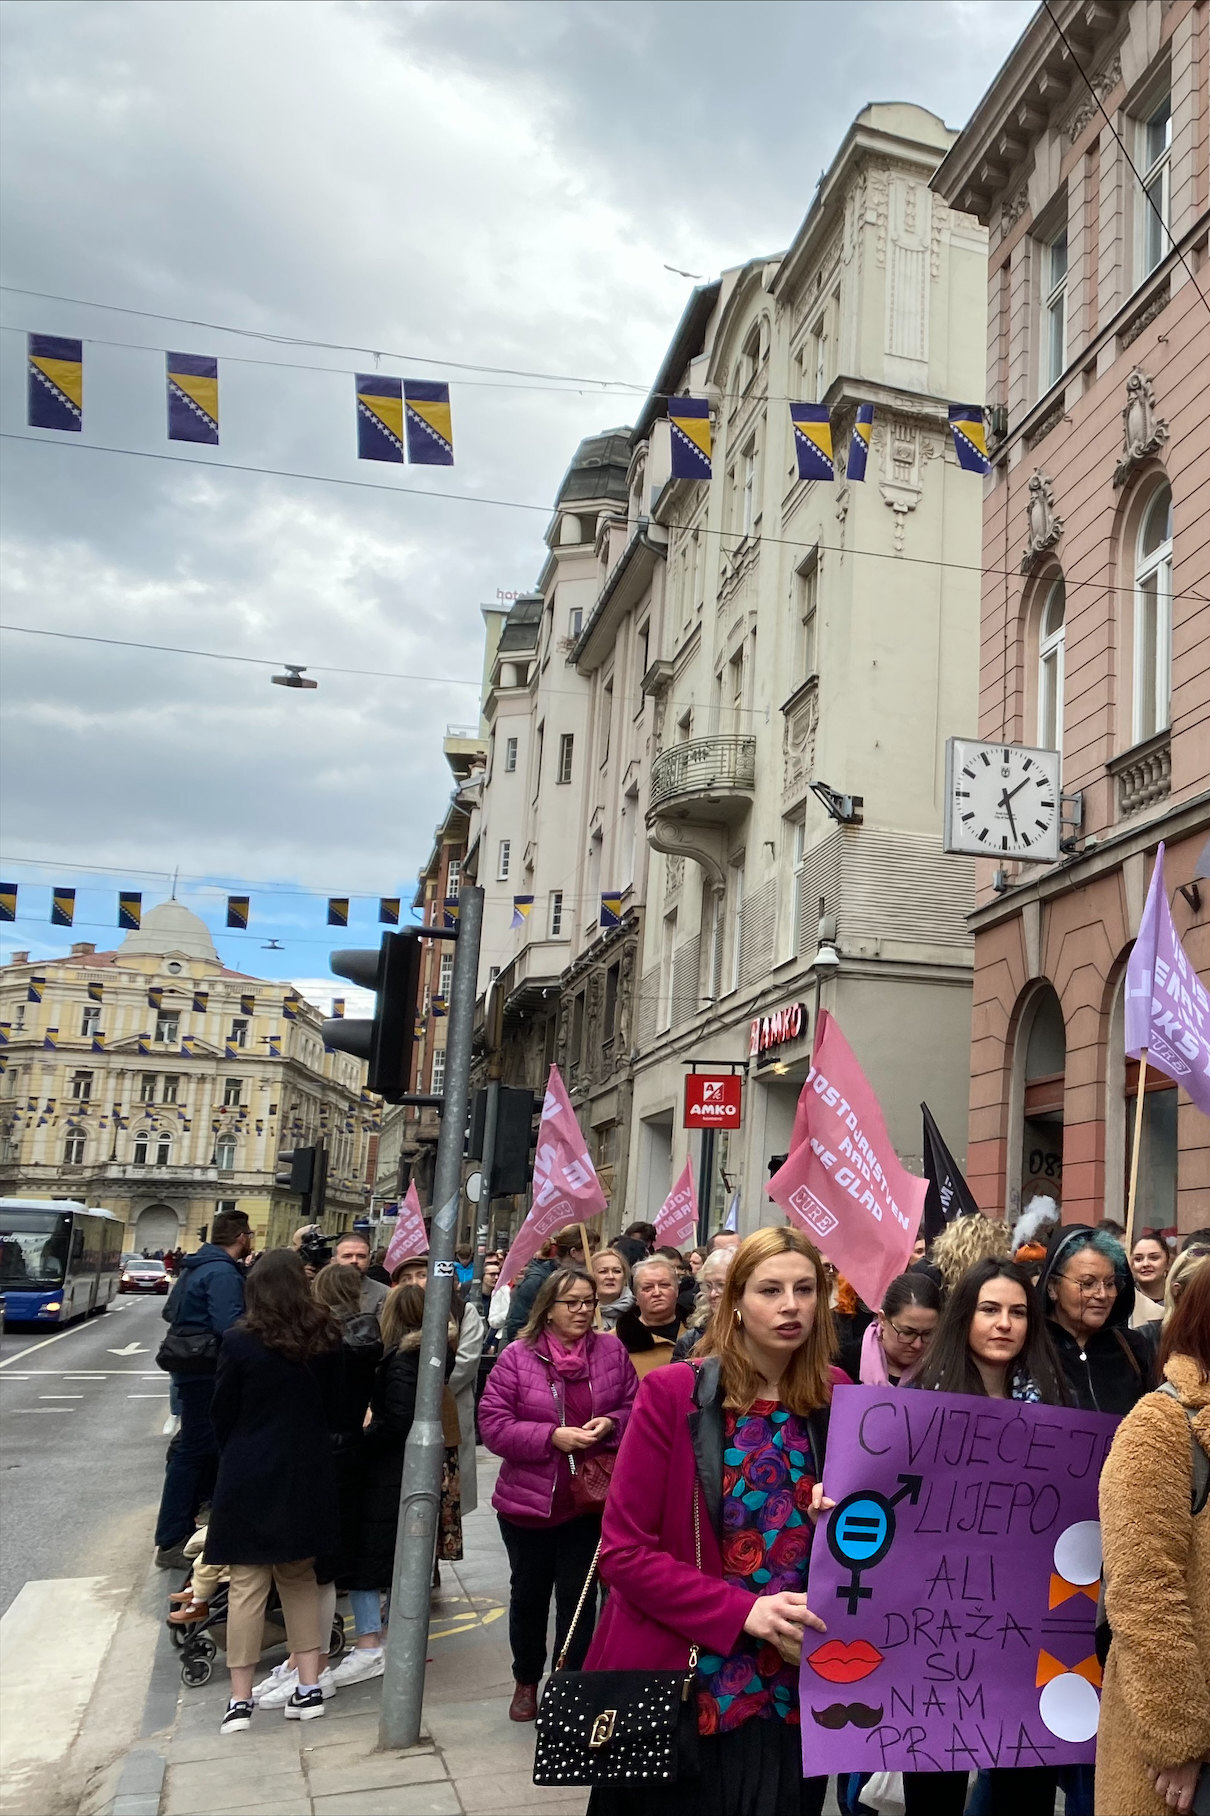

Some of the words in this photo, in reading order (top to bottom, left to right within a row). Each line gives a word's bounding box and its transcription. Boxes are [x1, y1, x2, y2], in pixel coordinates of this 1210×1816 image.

[759, 1002, 802, 1052] AMKO
[690, 1103, 737, 1116] AMKO
[834, 1166, 883, 1222] GLAD
[858, 1402, 1063, 1472] CVIJEĆE
[913, 1480, 1062, 1536] LIJEPO
[925, 1554, 997, 1601] ALI
[878, 1606, 1033, 1650] DRAŽA
[922, 1648, 976, 1682] SU
[890, 1682, 986, 1721] NAM
[865, 1720, 1056, 1772] PRAVA
